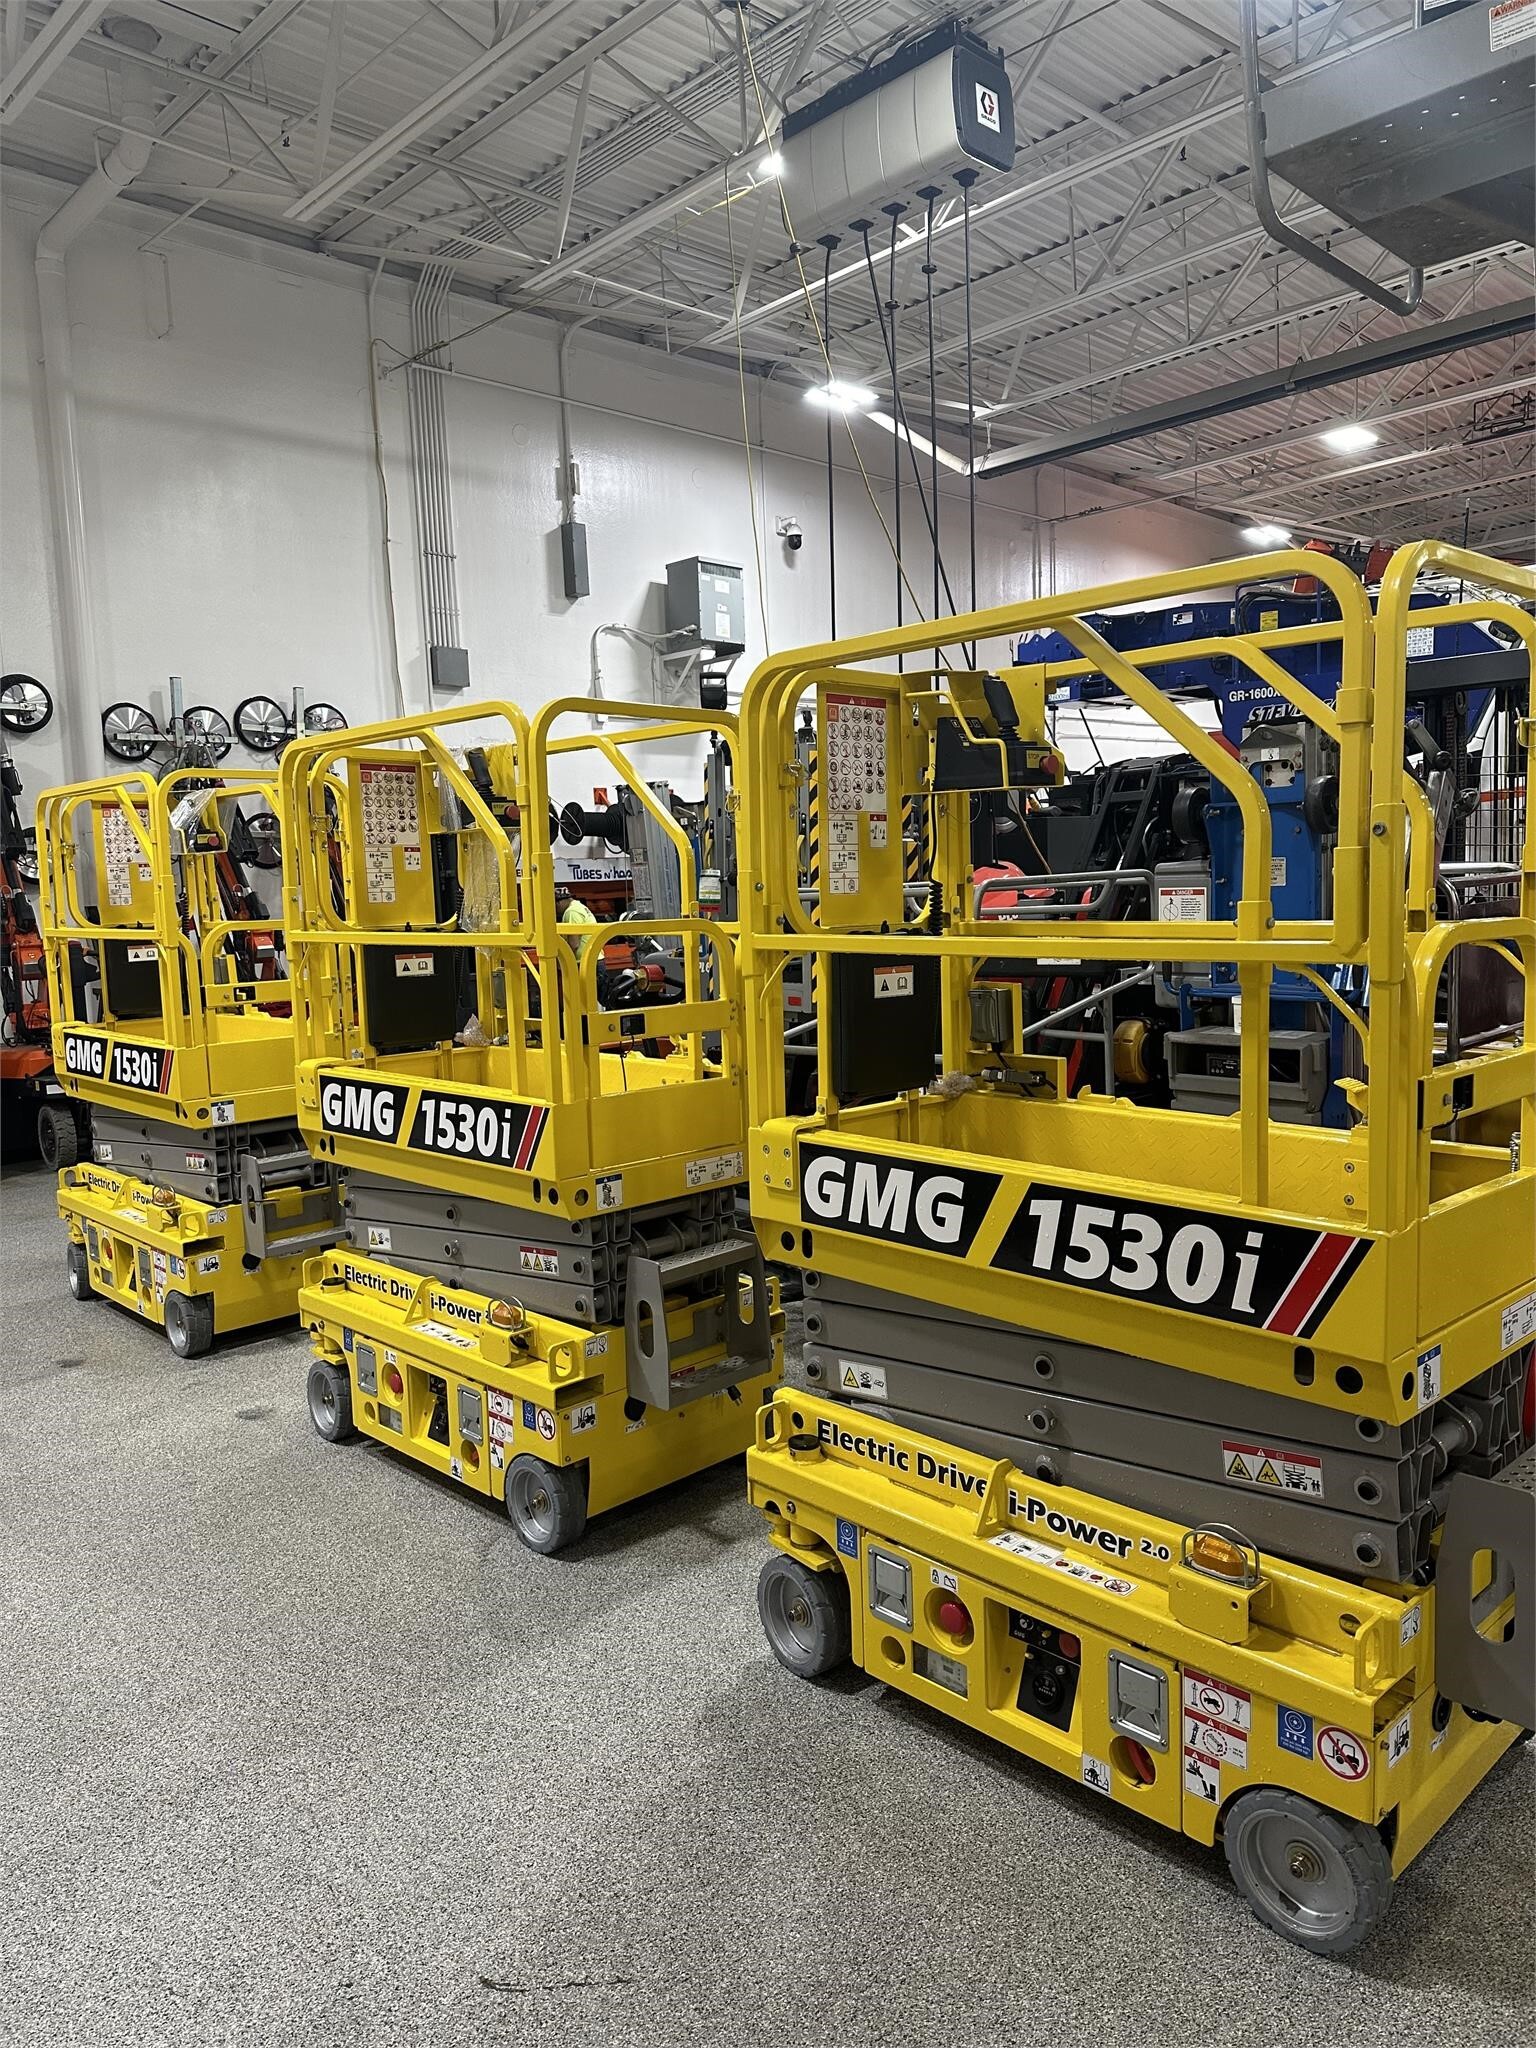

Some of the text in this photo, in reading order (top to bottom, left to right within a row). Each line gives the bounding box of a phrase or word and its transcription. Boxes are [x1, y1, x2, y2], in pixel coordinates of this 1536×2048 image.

[981, 113, 997, 124] GRACO
[567, 864, 602, 880] TUBES
[65, 1037, 158, 1087] GMG 1530i
[322, 1082, 511, 1160] GMG 1530i
[88, 1172, 110, 1191] Electric
[803, 1155, 1263, 1314] GMG 1530i
[344, 1264, 482, 1324] Electric Driv i-Power
[817, 1418, 1171, 1561] Electric Drive i-Power 2.0
